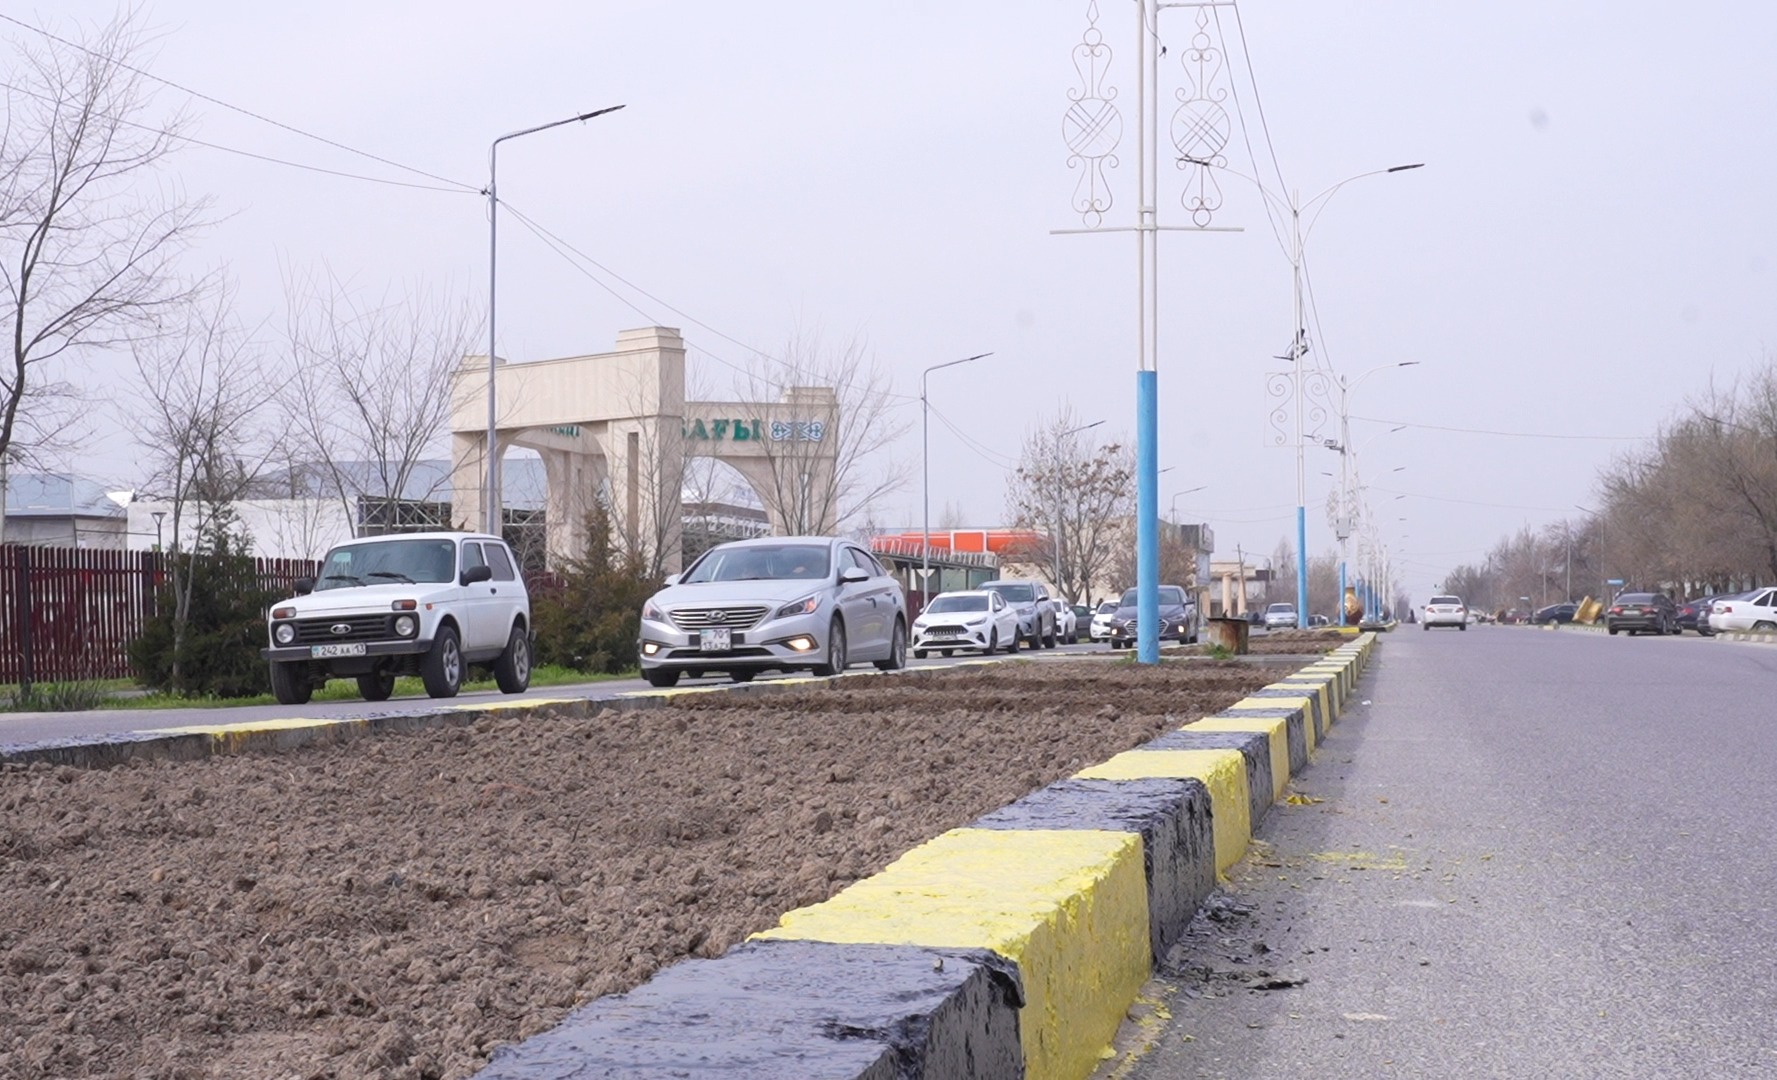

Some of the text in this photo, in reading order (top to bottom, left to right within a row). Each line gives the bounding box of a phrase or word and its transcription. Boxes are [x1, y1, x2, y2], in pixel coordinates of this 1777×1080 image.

[681, 417, 760, 441] АҒЫ
[321, 645, 338, 656] 242
[354, 643, 365, 654] 13
